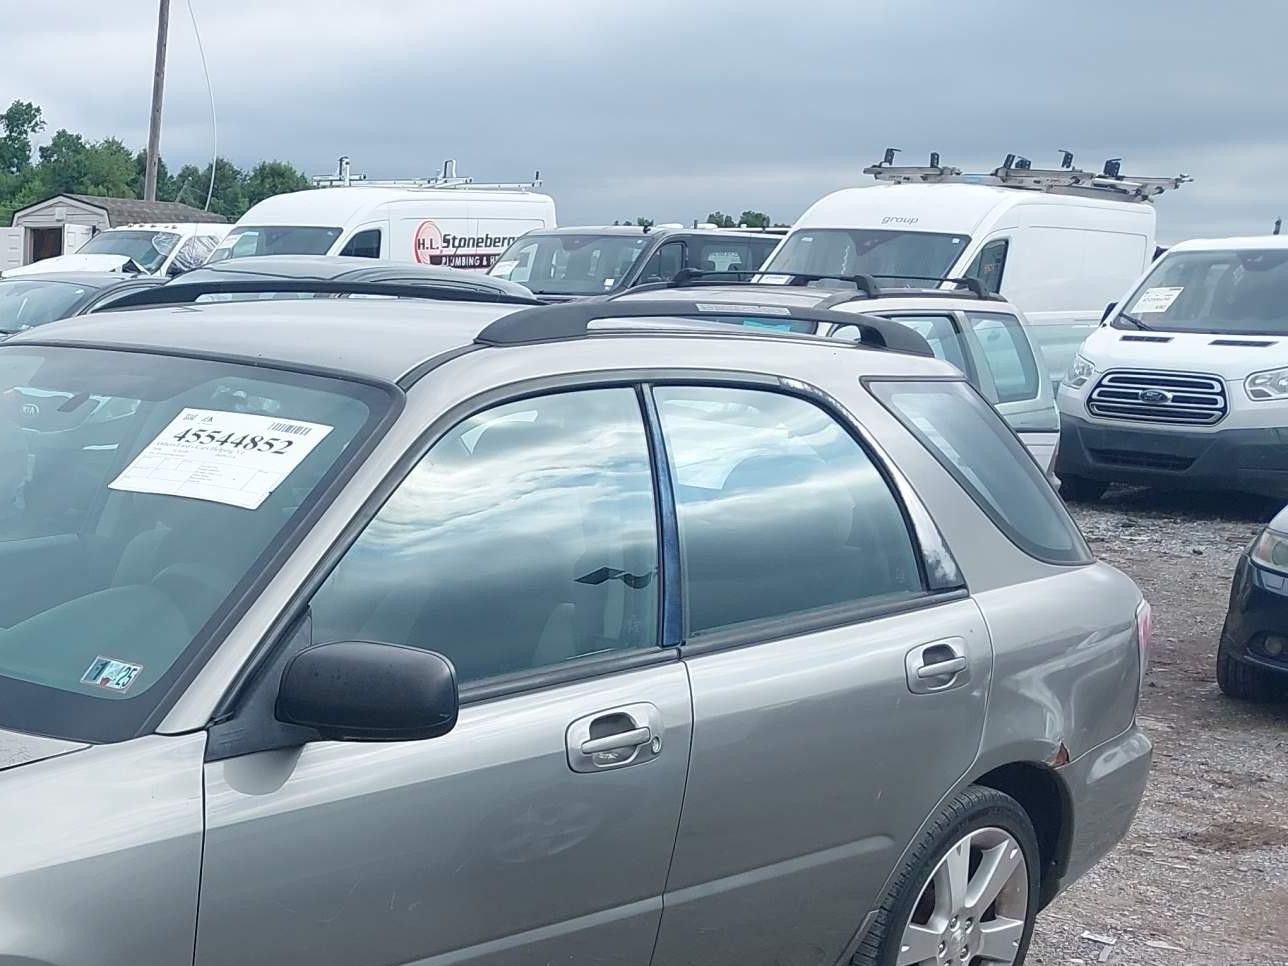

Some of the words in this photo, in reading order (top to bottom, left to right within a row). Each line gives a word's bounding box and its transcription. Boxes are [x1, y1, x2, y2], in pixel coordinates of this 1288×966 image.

[880, 215, 919, 225] group
[417, 238, 440, 250] H.L.
[442, 233, 521, 249] Stoneberg
[173, 427, 294, 455] 45544852
